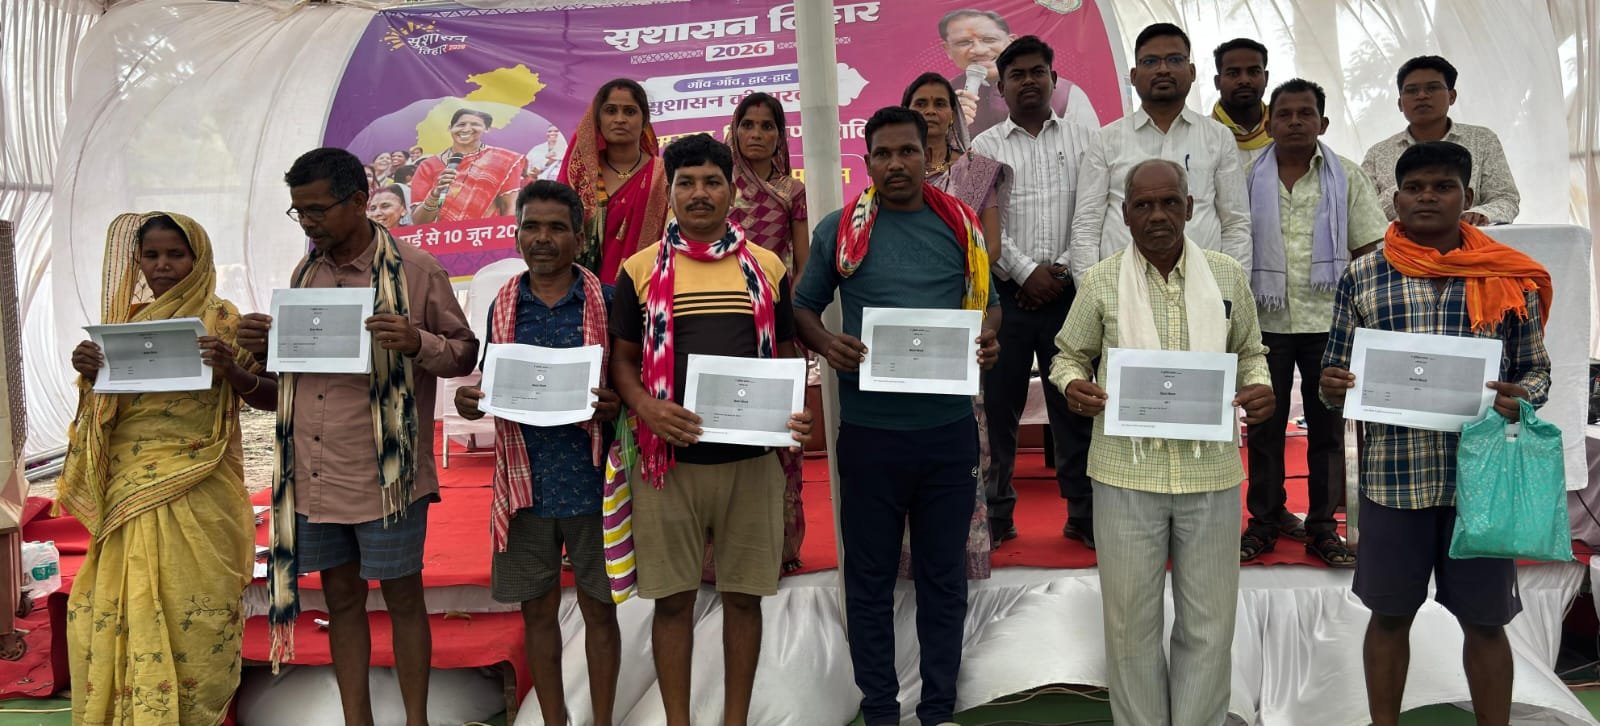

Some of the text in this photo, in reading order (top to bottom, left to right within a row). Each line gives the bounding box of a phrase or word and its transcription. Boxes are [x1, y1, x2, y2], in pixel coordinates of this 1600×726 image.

[407, 33, 469, 49] सुशासन
[602, 16, 758, 51] सुशासन
[418, 43, 447, 56] तिहार
[712, 42, 768, 59] 2026
[425, 228, 441, 246] से
[443, 229, 463, 244] 10
[465, 225, 493, 247] जून
[495, 224, 517, 239] 20
